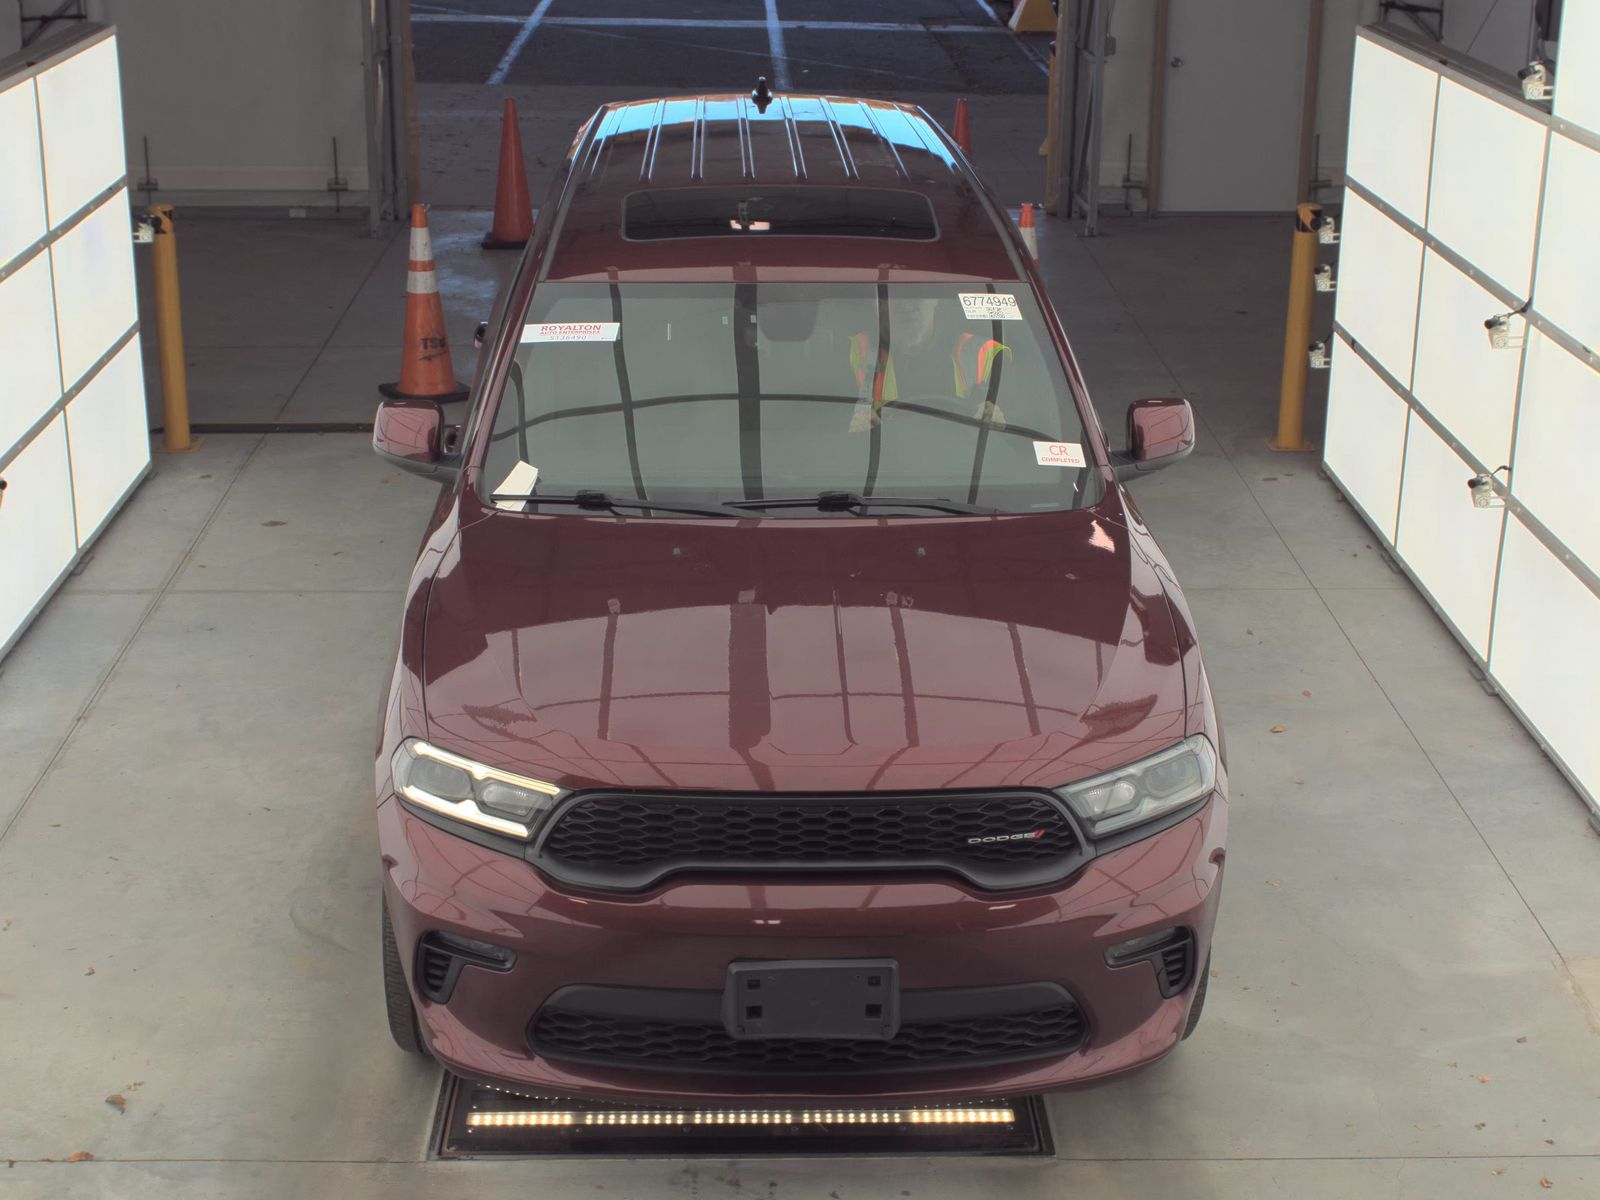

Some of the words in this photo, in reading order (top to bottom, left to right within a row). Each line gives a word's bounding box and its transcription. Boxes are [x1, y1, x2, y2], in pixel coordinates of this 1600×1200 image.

[962, 296, 1017, 307] 6774949
[1049, 445, 1070, 456] CR
[1041, 456, 1080, 464] COMPLETED
[967, 832, 1036, 844] DODGE
